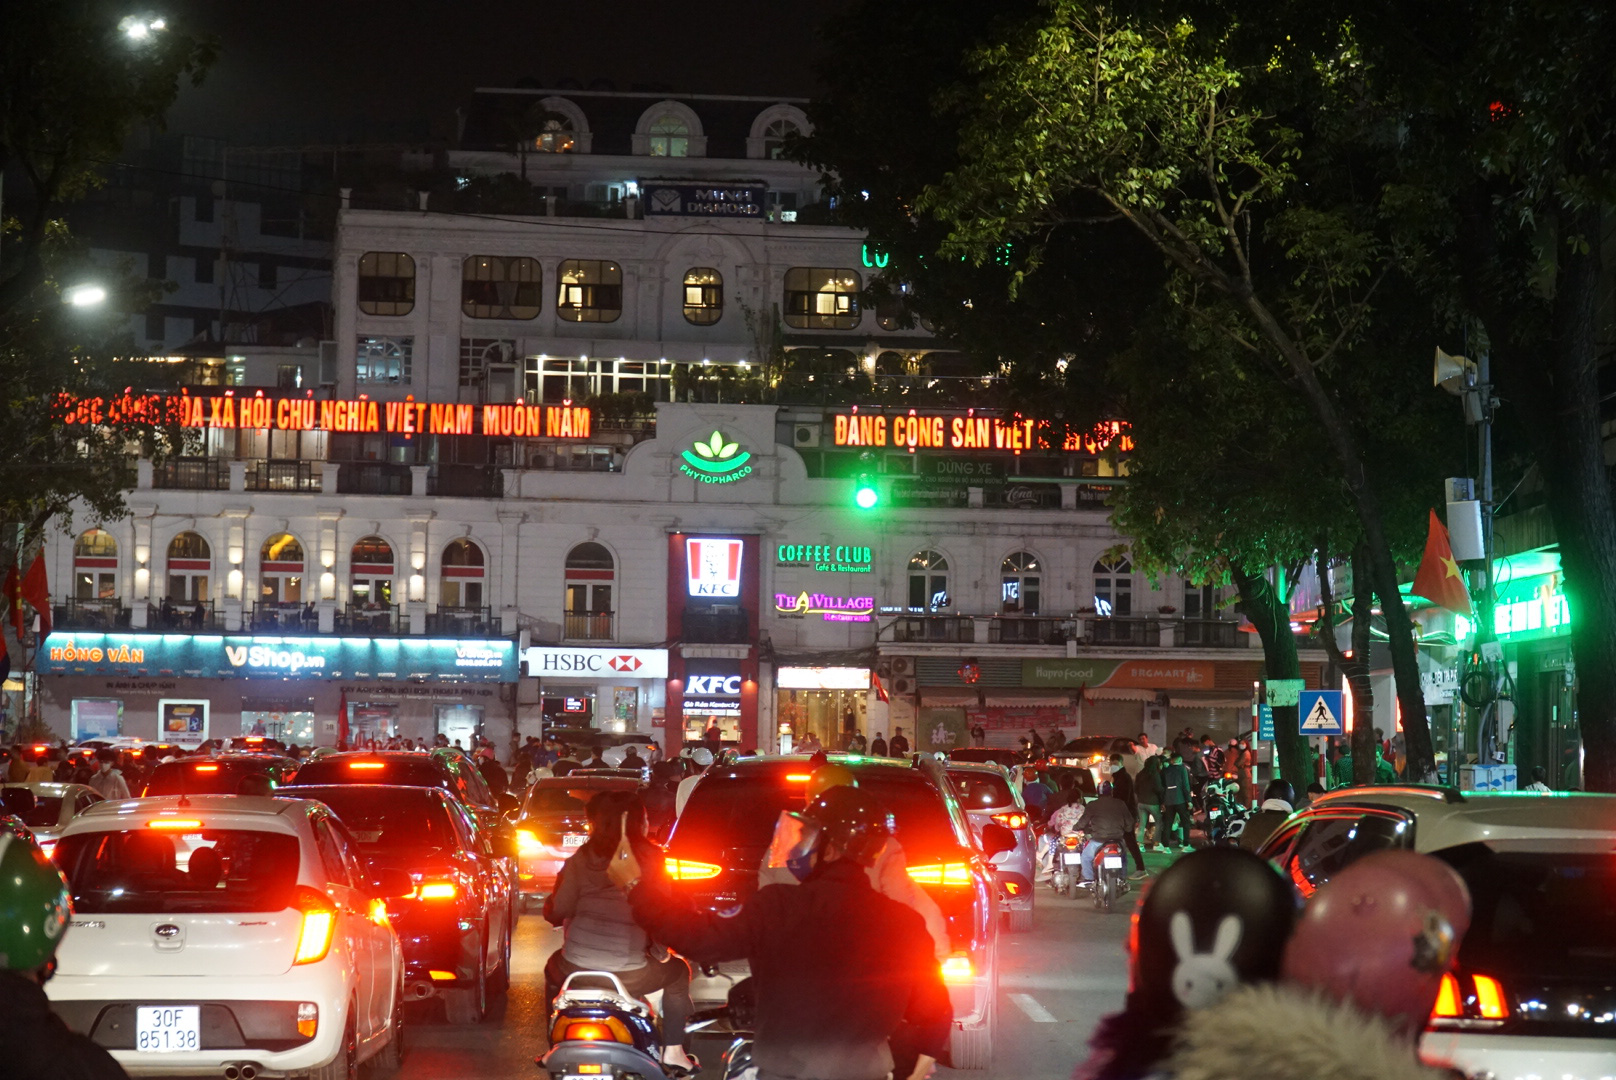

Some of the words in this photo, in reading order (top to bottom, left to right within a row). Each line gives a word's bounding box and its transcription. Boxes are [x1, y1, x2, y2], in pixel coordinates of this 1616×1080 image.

[696, 189, 752, 202] MINH
[687, 202, 760, 215] DIAMOND
[209, 390, 236, 428] XÃ
[240, 389, 271, 436] HỘI
[277, 389, 316, 430] CHỦ
[320, 394, 379, 432] NGHĨA
[385, 394, 426, 439] VIỆT
[429, 403, 474, 435] NAM
[483, 397, 541, 437] MUÔN
[547, 399, 590, 438] NĂM
[835, 405, 886, 447] ĐẢNG
[893, 409, 944, 453] CỘNG
[951, 408, 989, 448] SẢN
[995, 411, 1034, 455] VIỆT
[680, 464, 752, 484] PHYTOPHARCO
[978, 463, 992, 475] XE
[778, 544, 831, 562] COFFEE
[836, 546, 872, 563] CLUB
[815, 563, 829, 571] Café
[830, 564, 836, 572] &
[838, 564, 872, 572] Restaurant
[698, 583, 733, 595] KFC
[824, 613, 871, 622] Restaurants
[50, 641, 104, 663] HỒNG
[107, 644, 144, 663] VÂN
[543, 654, 602, 671] HSBC
[685, 676, 742, 693] KFC
[709, 701, 740, 709] Kentucky
[152, 1009, 184, 1028] 30F
[139, 1030, 196, 1049] 851.38
